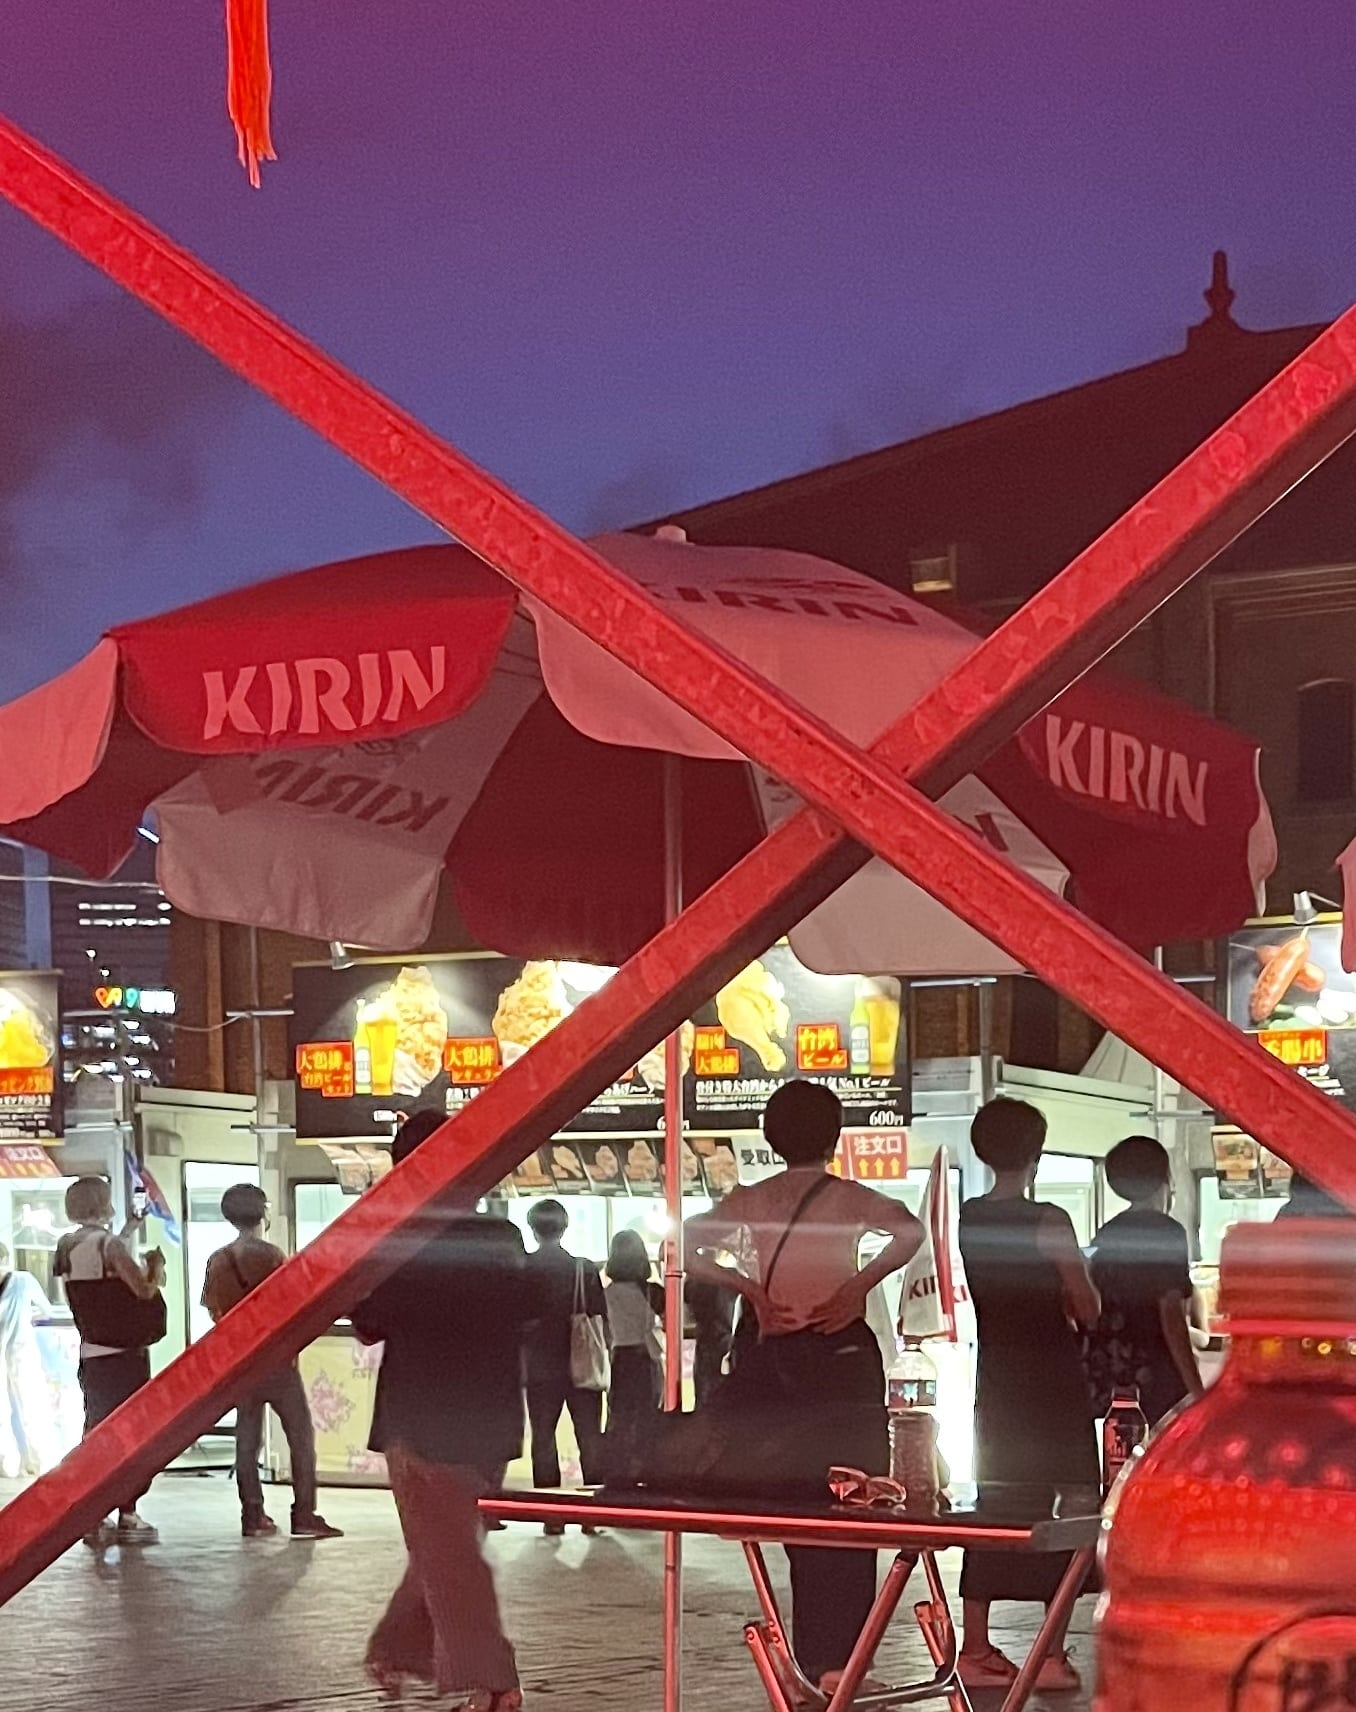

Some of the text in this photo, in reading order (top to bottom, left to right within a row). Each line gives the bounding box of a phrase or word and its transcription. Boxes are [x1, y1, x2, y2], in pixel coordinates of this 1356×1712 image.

[640, 581, 918, 626] IRIN
[203, 646, 445, 739] KIRIN
[1046, 714, 1208, 826] KIRIN
[803, 1051, 844, 1066] ビール
[869, 1110, 904, 1126] 600円
[854, 1135, 902, 1155] 注文口
